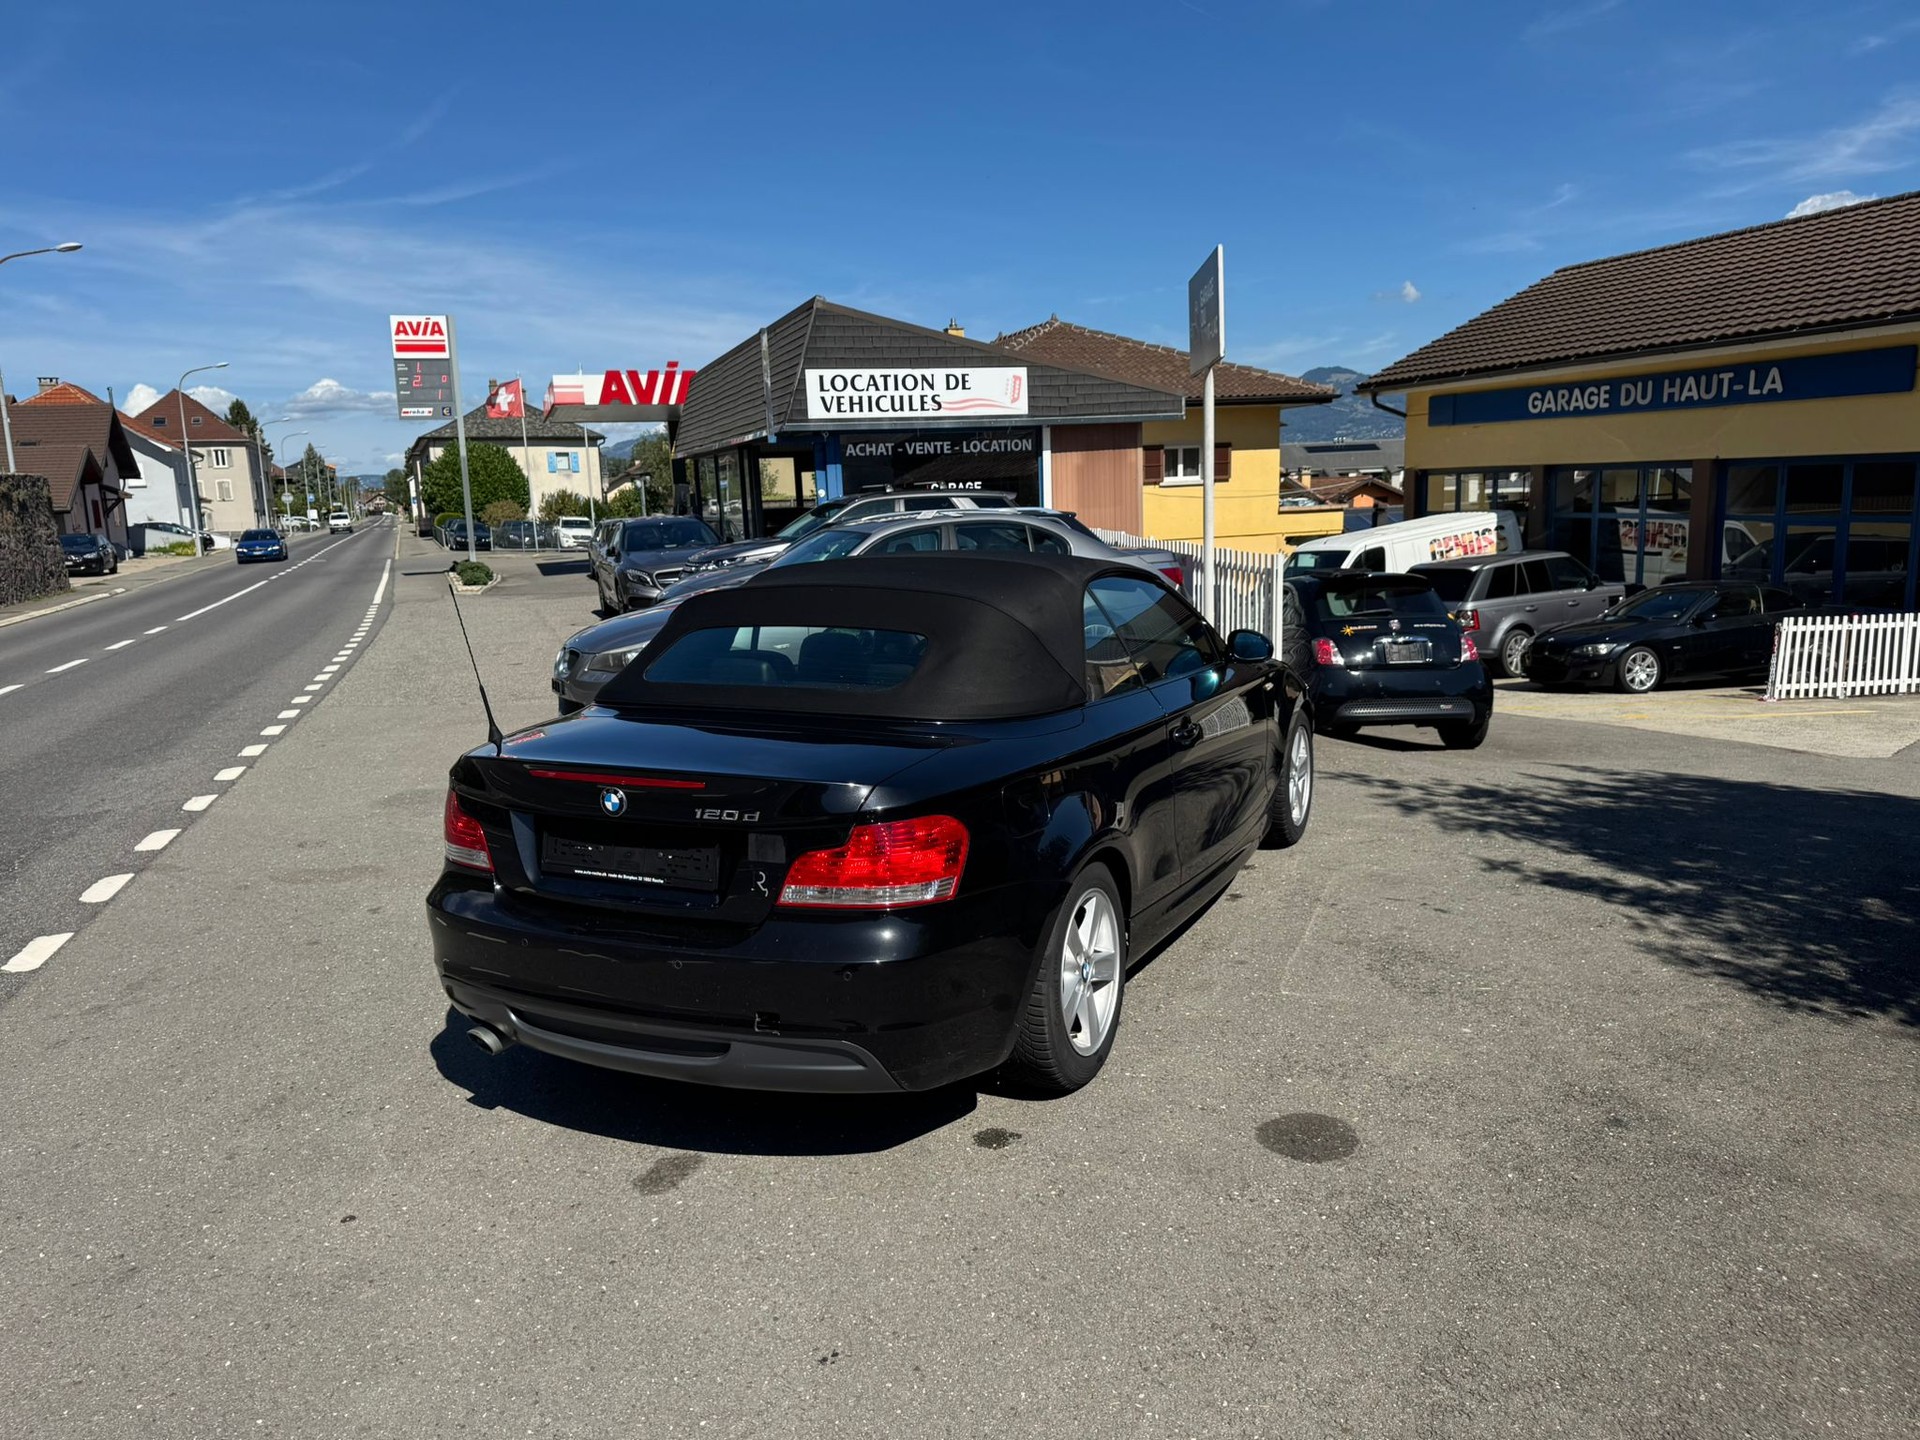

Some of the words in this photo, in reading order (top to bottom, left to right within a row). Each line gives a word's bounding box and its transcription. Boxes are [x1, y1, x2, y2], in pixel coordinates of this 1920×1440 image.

[394, 317, 445, 336] AVIA
[818, 374, 935, 392] LOCATION
[945, 373, 972, 390] DE
[1528, 385, 1610, 414] GARAGE
[1620, 381, 1653, 407] DU
[1662, 367, 1784, 402] HAUT-LA
[820, 394, 943, 413] VEHICULES
[846, 442, 895, 457] ACHAT
[905, 441, 951, 455] VENTE
[962, 439, 1032, 453] LOCATION
